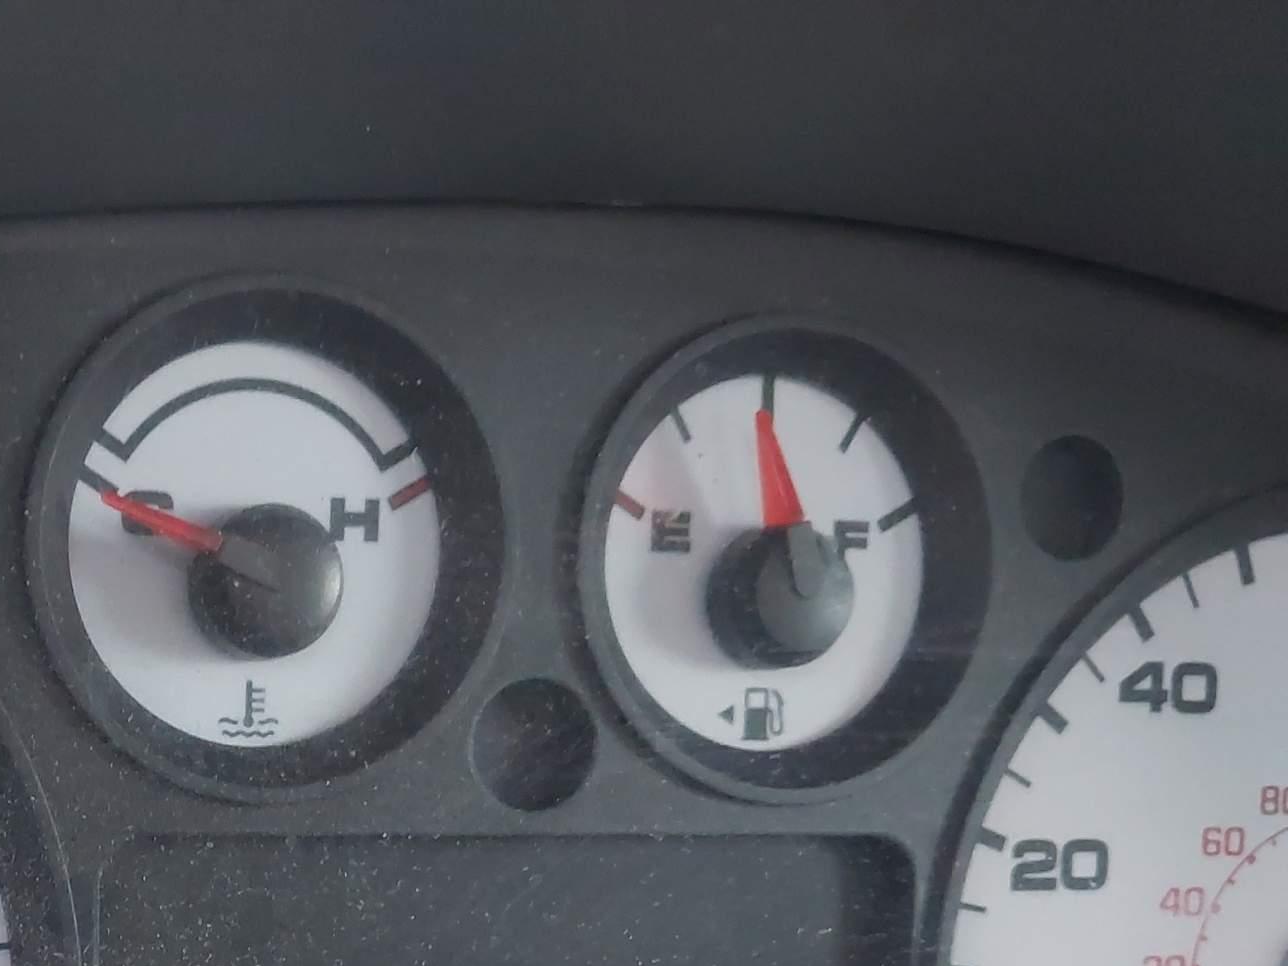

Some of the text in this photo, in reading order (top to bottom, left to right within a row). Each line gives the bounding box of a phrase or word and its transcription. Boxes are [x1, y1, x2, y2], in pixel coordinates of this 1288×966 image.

[329, 496, 379, 542] H
[651, 510, 691, 552] E
[834, 520, 870, 556] F
[1118, 661, 1219, 715] 40
[1201, 826, 1245, 857] 60
[1011, 838, 1110, 892] 20
[1160, 886, 1205, 917] 40
